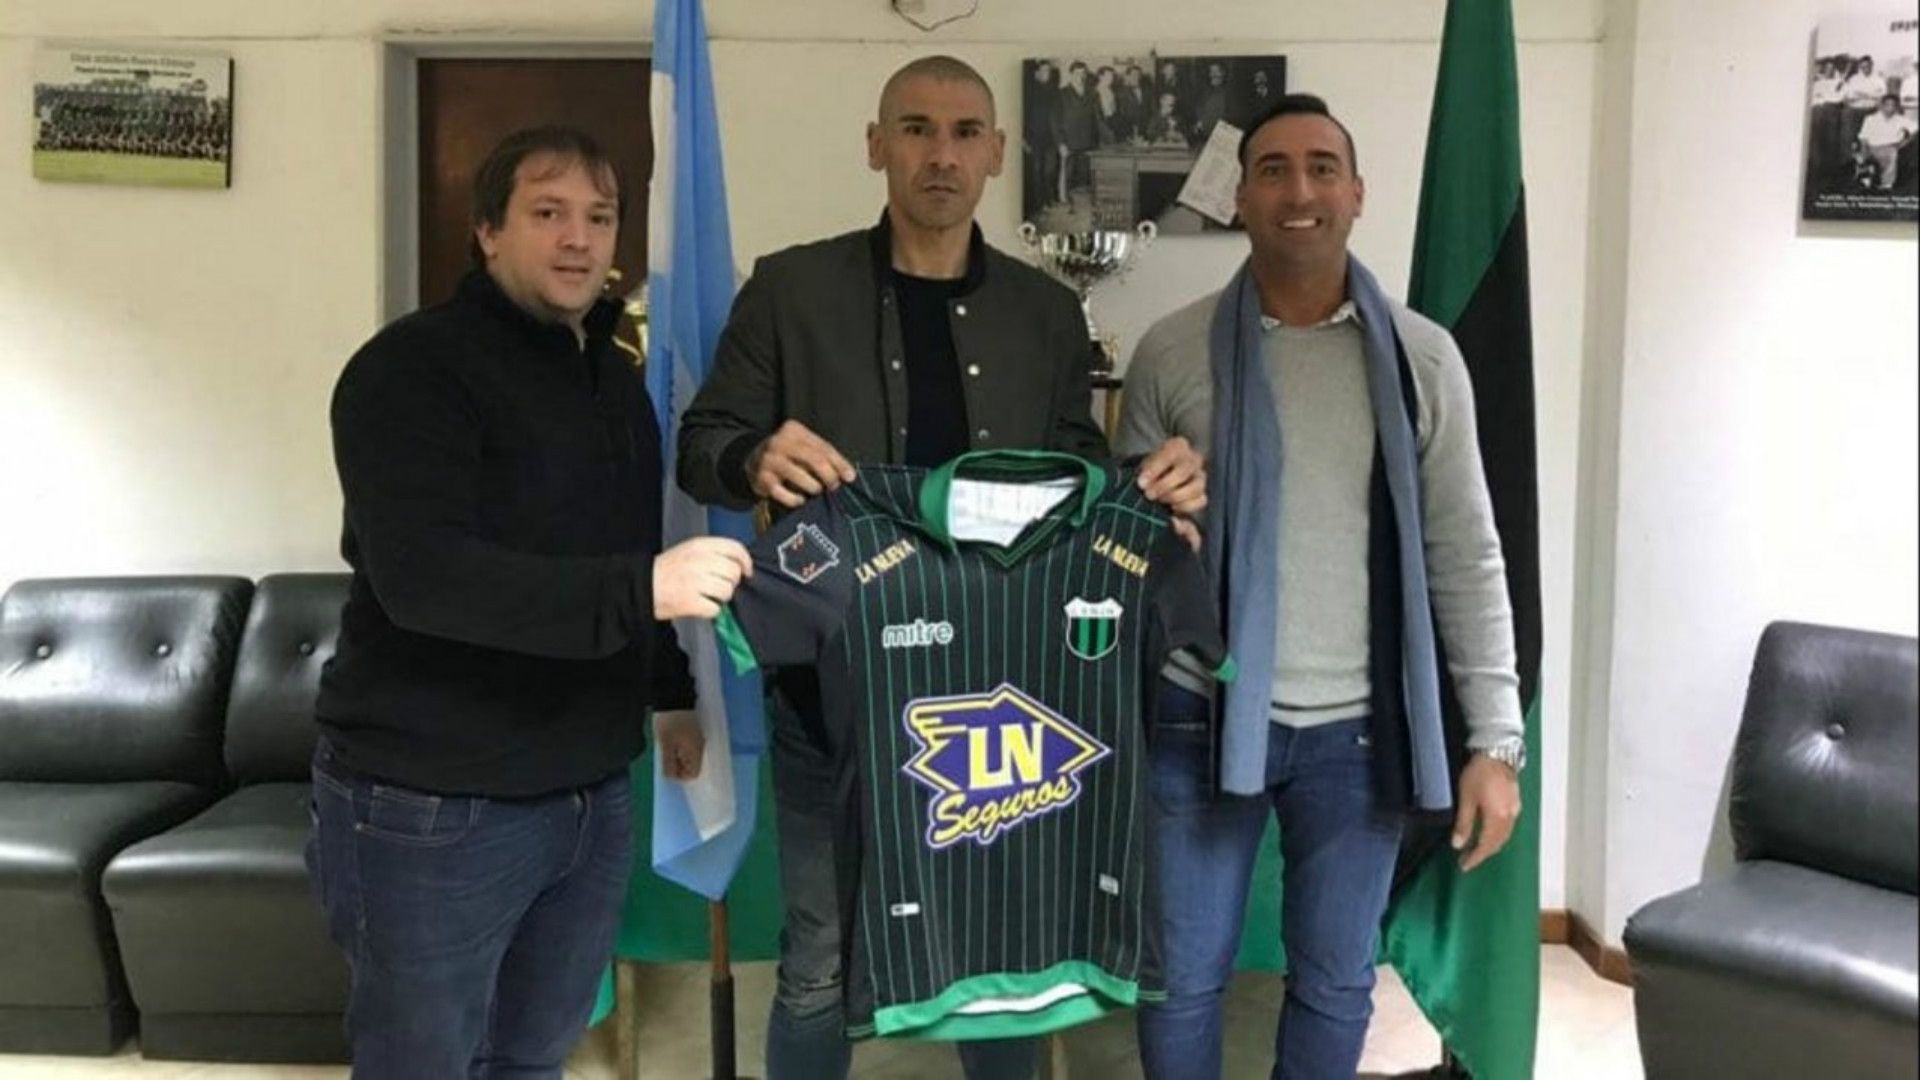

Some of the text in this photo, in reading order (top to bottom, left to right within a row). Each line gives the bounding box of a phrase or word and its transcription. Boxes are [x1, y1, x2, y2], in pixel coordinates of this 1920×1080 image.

[855, 538, 916, 584] LA NUEVA
[1093, 534, 1150, 577] LA NUEVA
[882, 618, 954, 648] mitre
[968, 722, 1044, 789] LN
[933, 775, 1072, 841] Seguros
